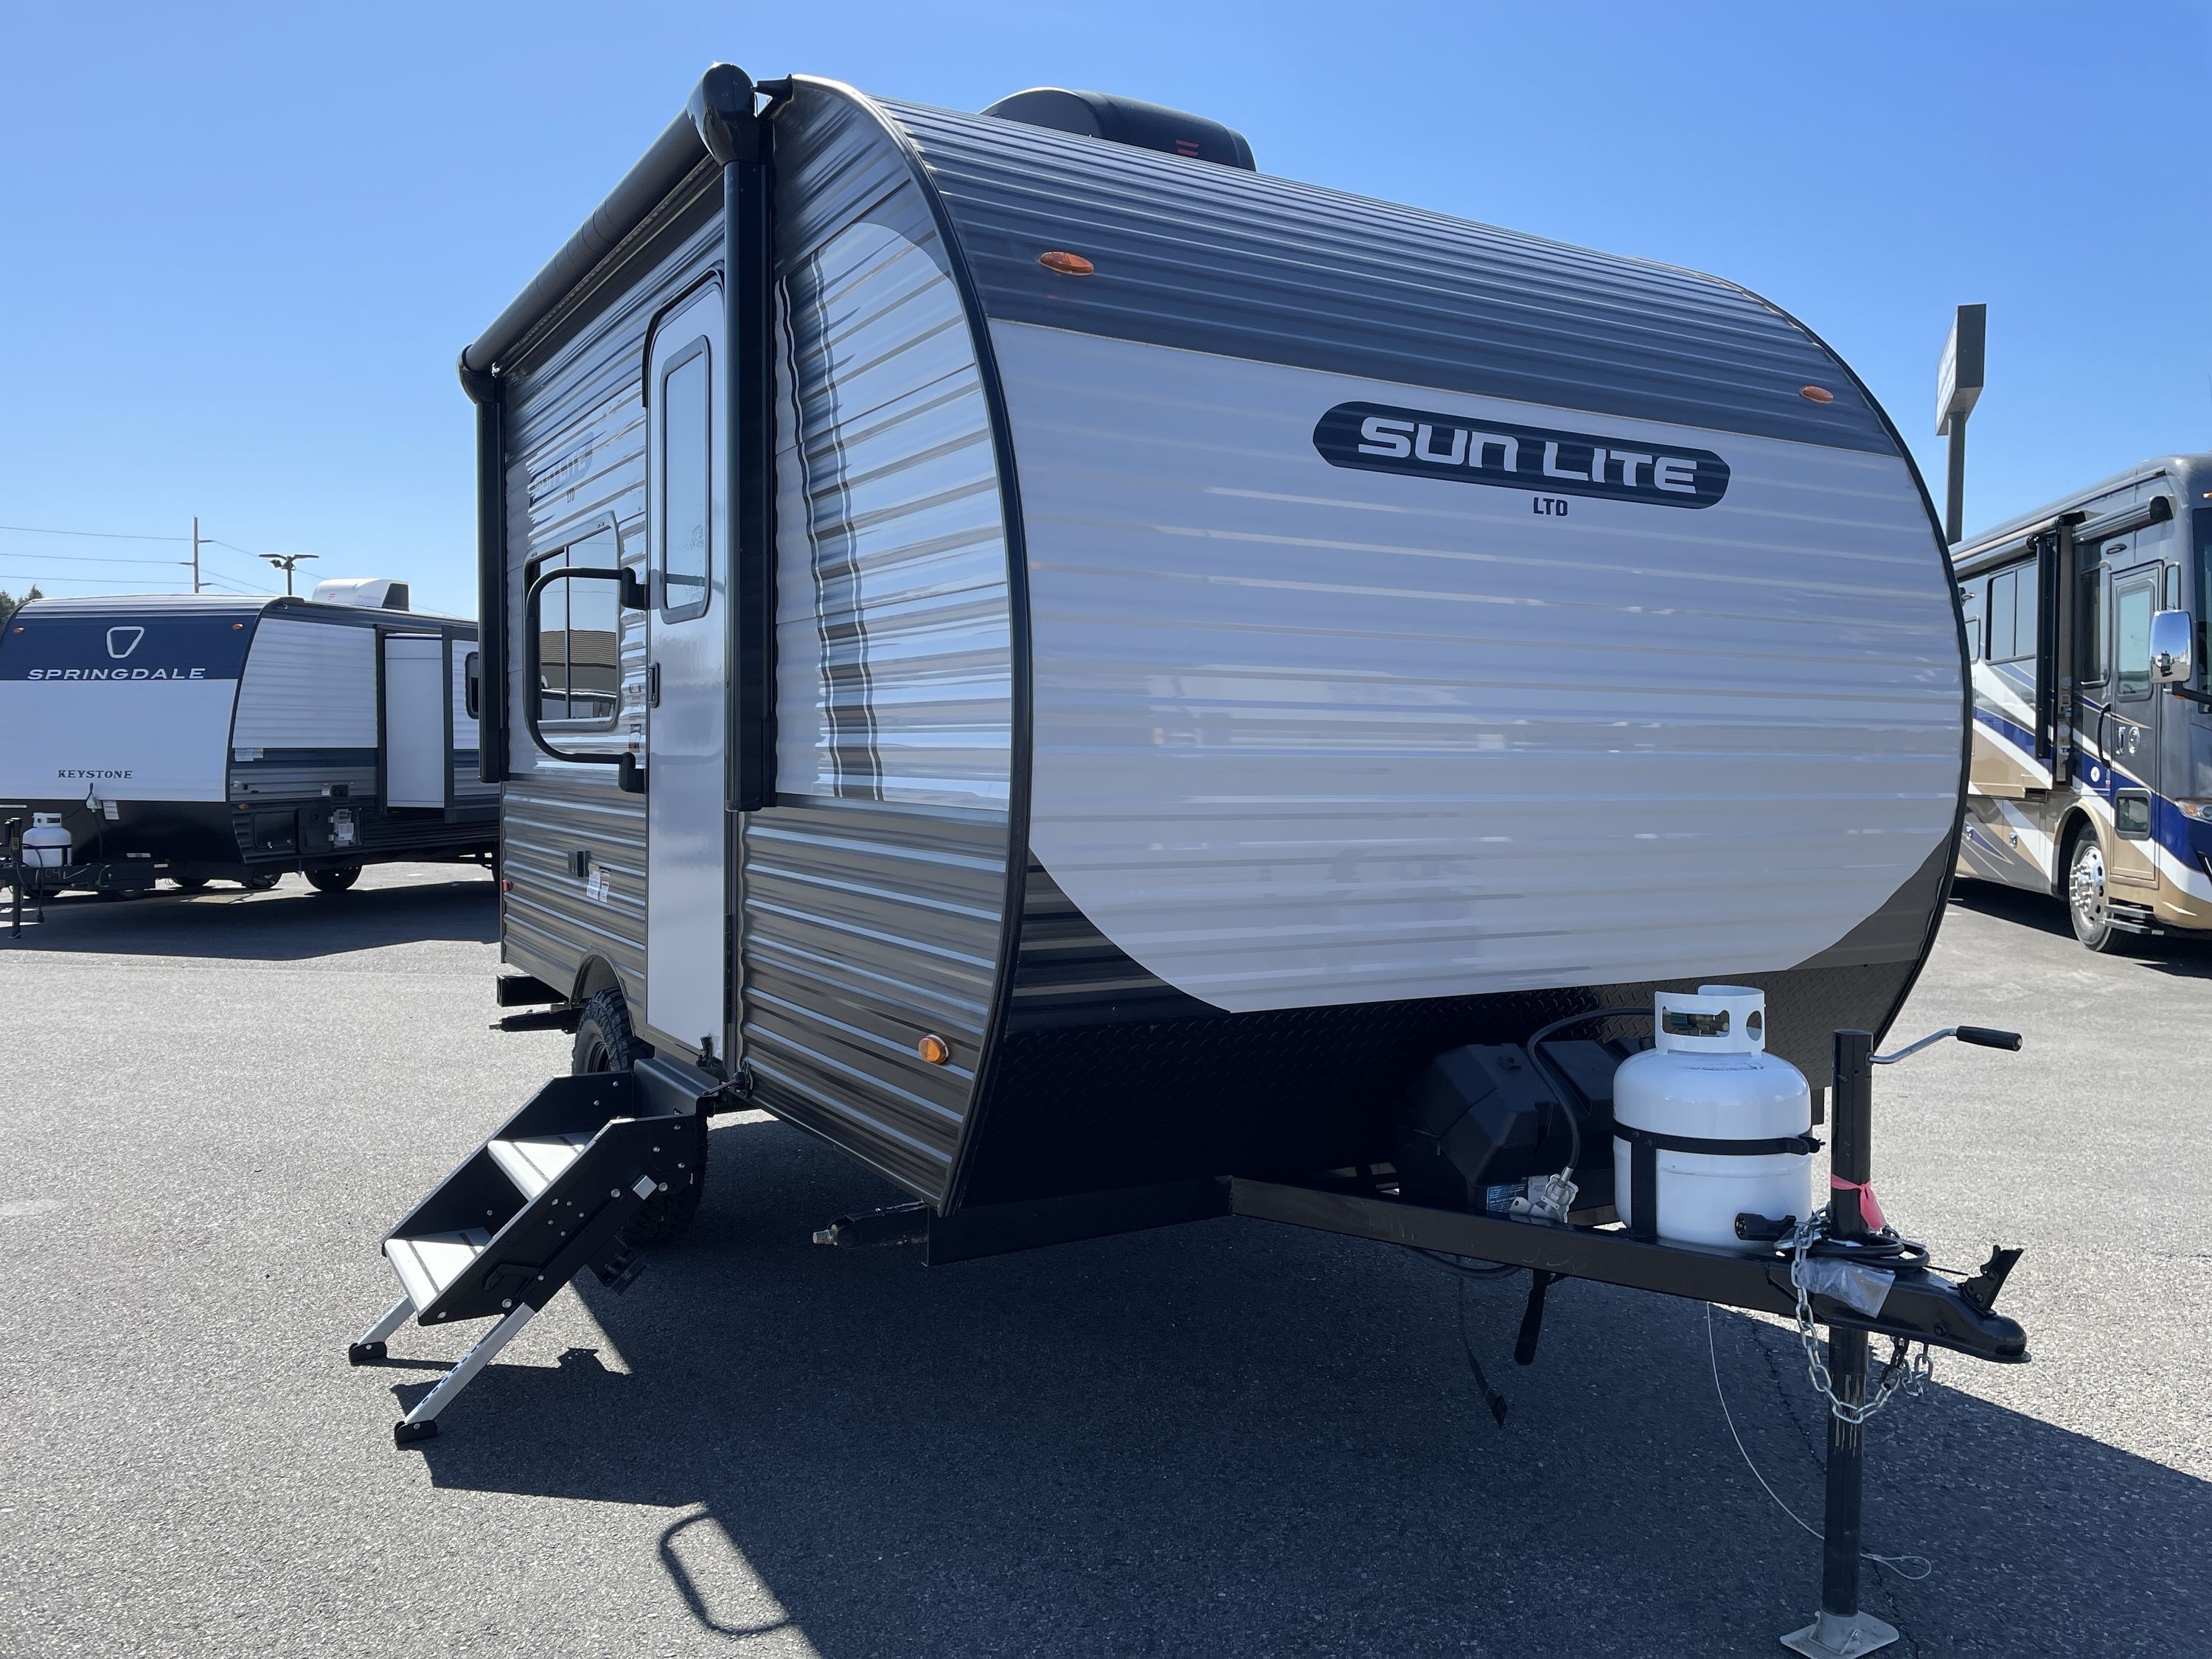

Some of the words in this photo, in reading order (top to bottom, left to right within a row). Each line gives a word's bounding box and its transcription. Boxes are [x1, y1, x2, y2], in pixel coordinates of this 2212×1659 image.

[1358, 417, 1518, 473] SUN
[1543, 441, 1697, 494] LITE
[1533, 497, 1568, 517] LTD
[27, 668, 206, 680] SPRINGDALE
[58, 770, 133, 779] KEYSTONE
